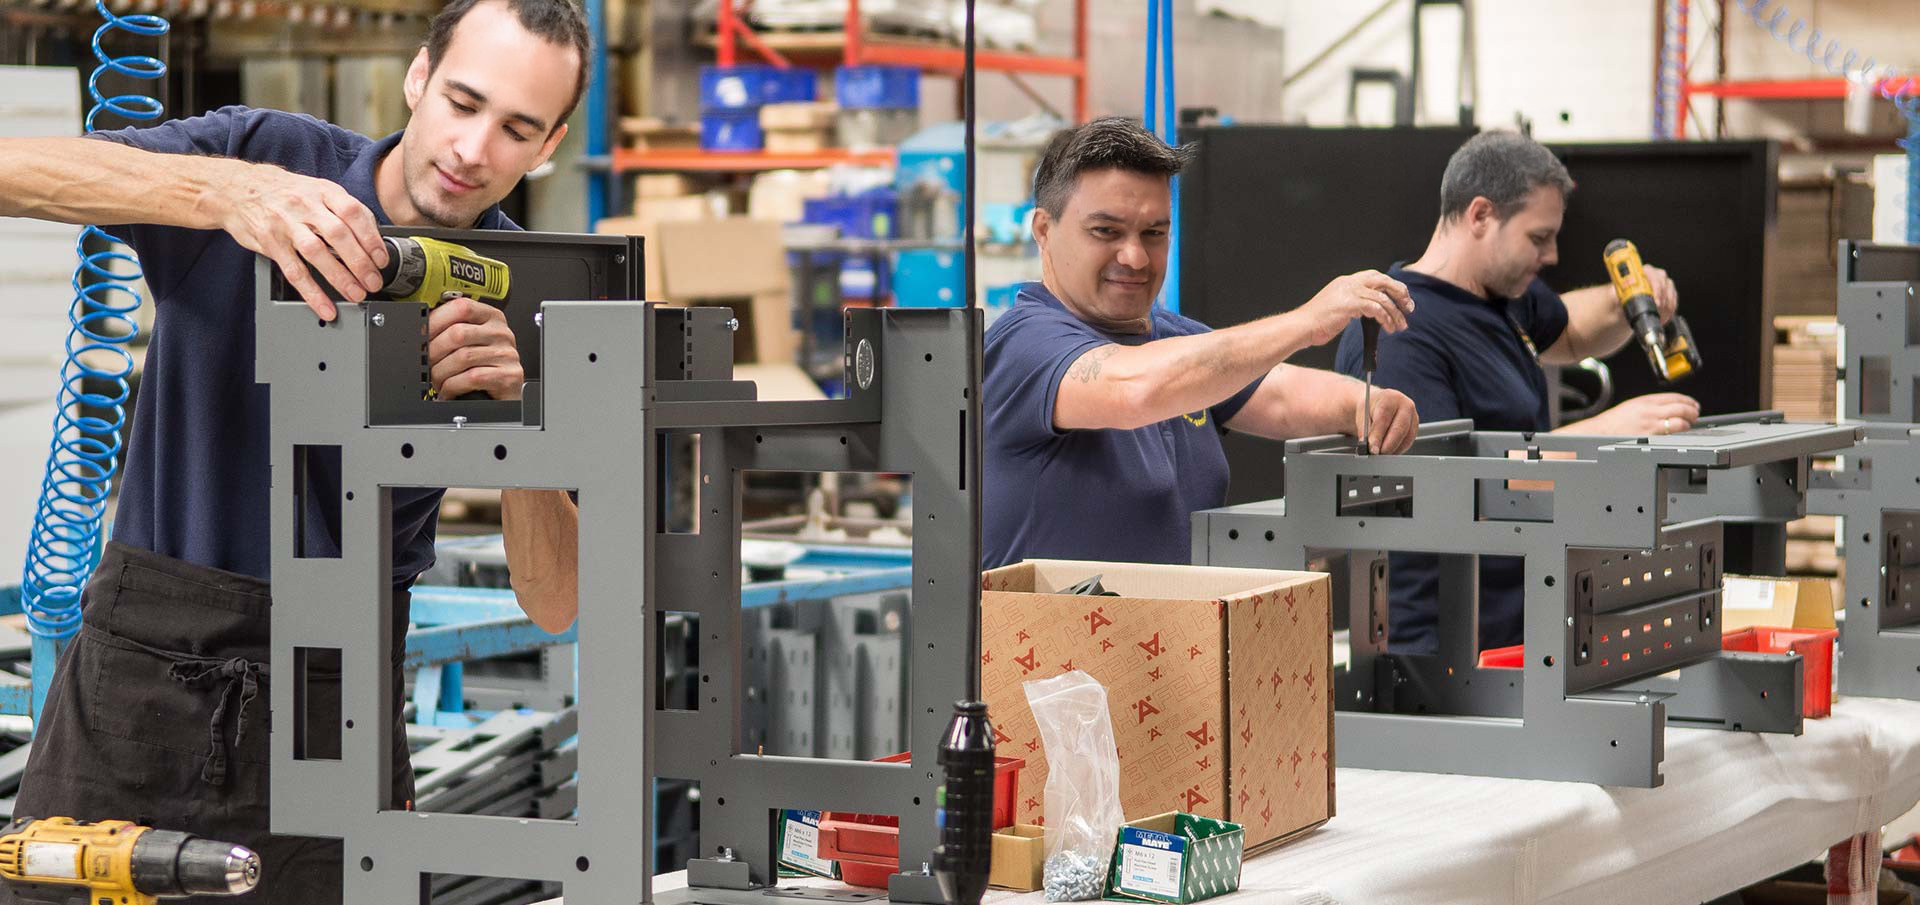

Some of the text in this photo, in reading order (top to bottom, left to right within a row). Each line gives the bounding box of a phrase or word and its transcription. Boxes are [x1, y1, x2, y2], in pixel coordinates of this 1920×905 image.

[452, 260, 484, 282] RYOBI
[1135, 830, 1170, 842] METAL
[1141, 838, 1170, 850] MATE
